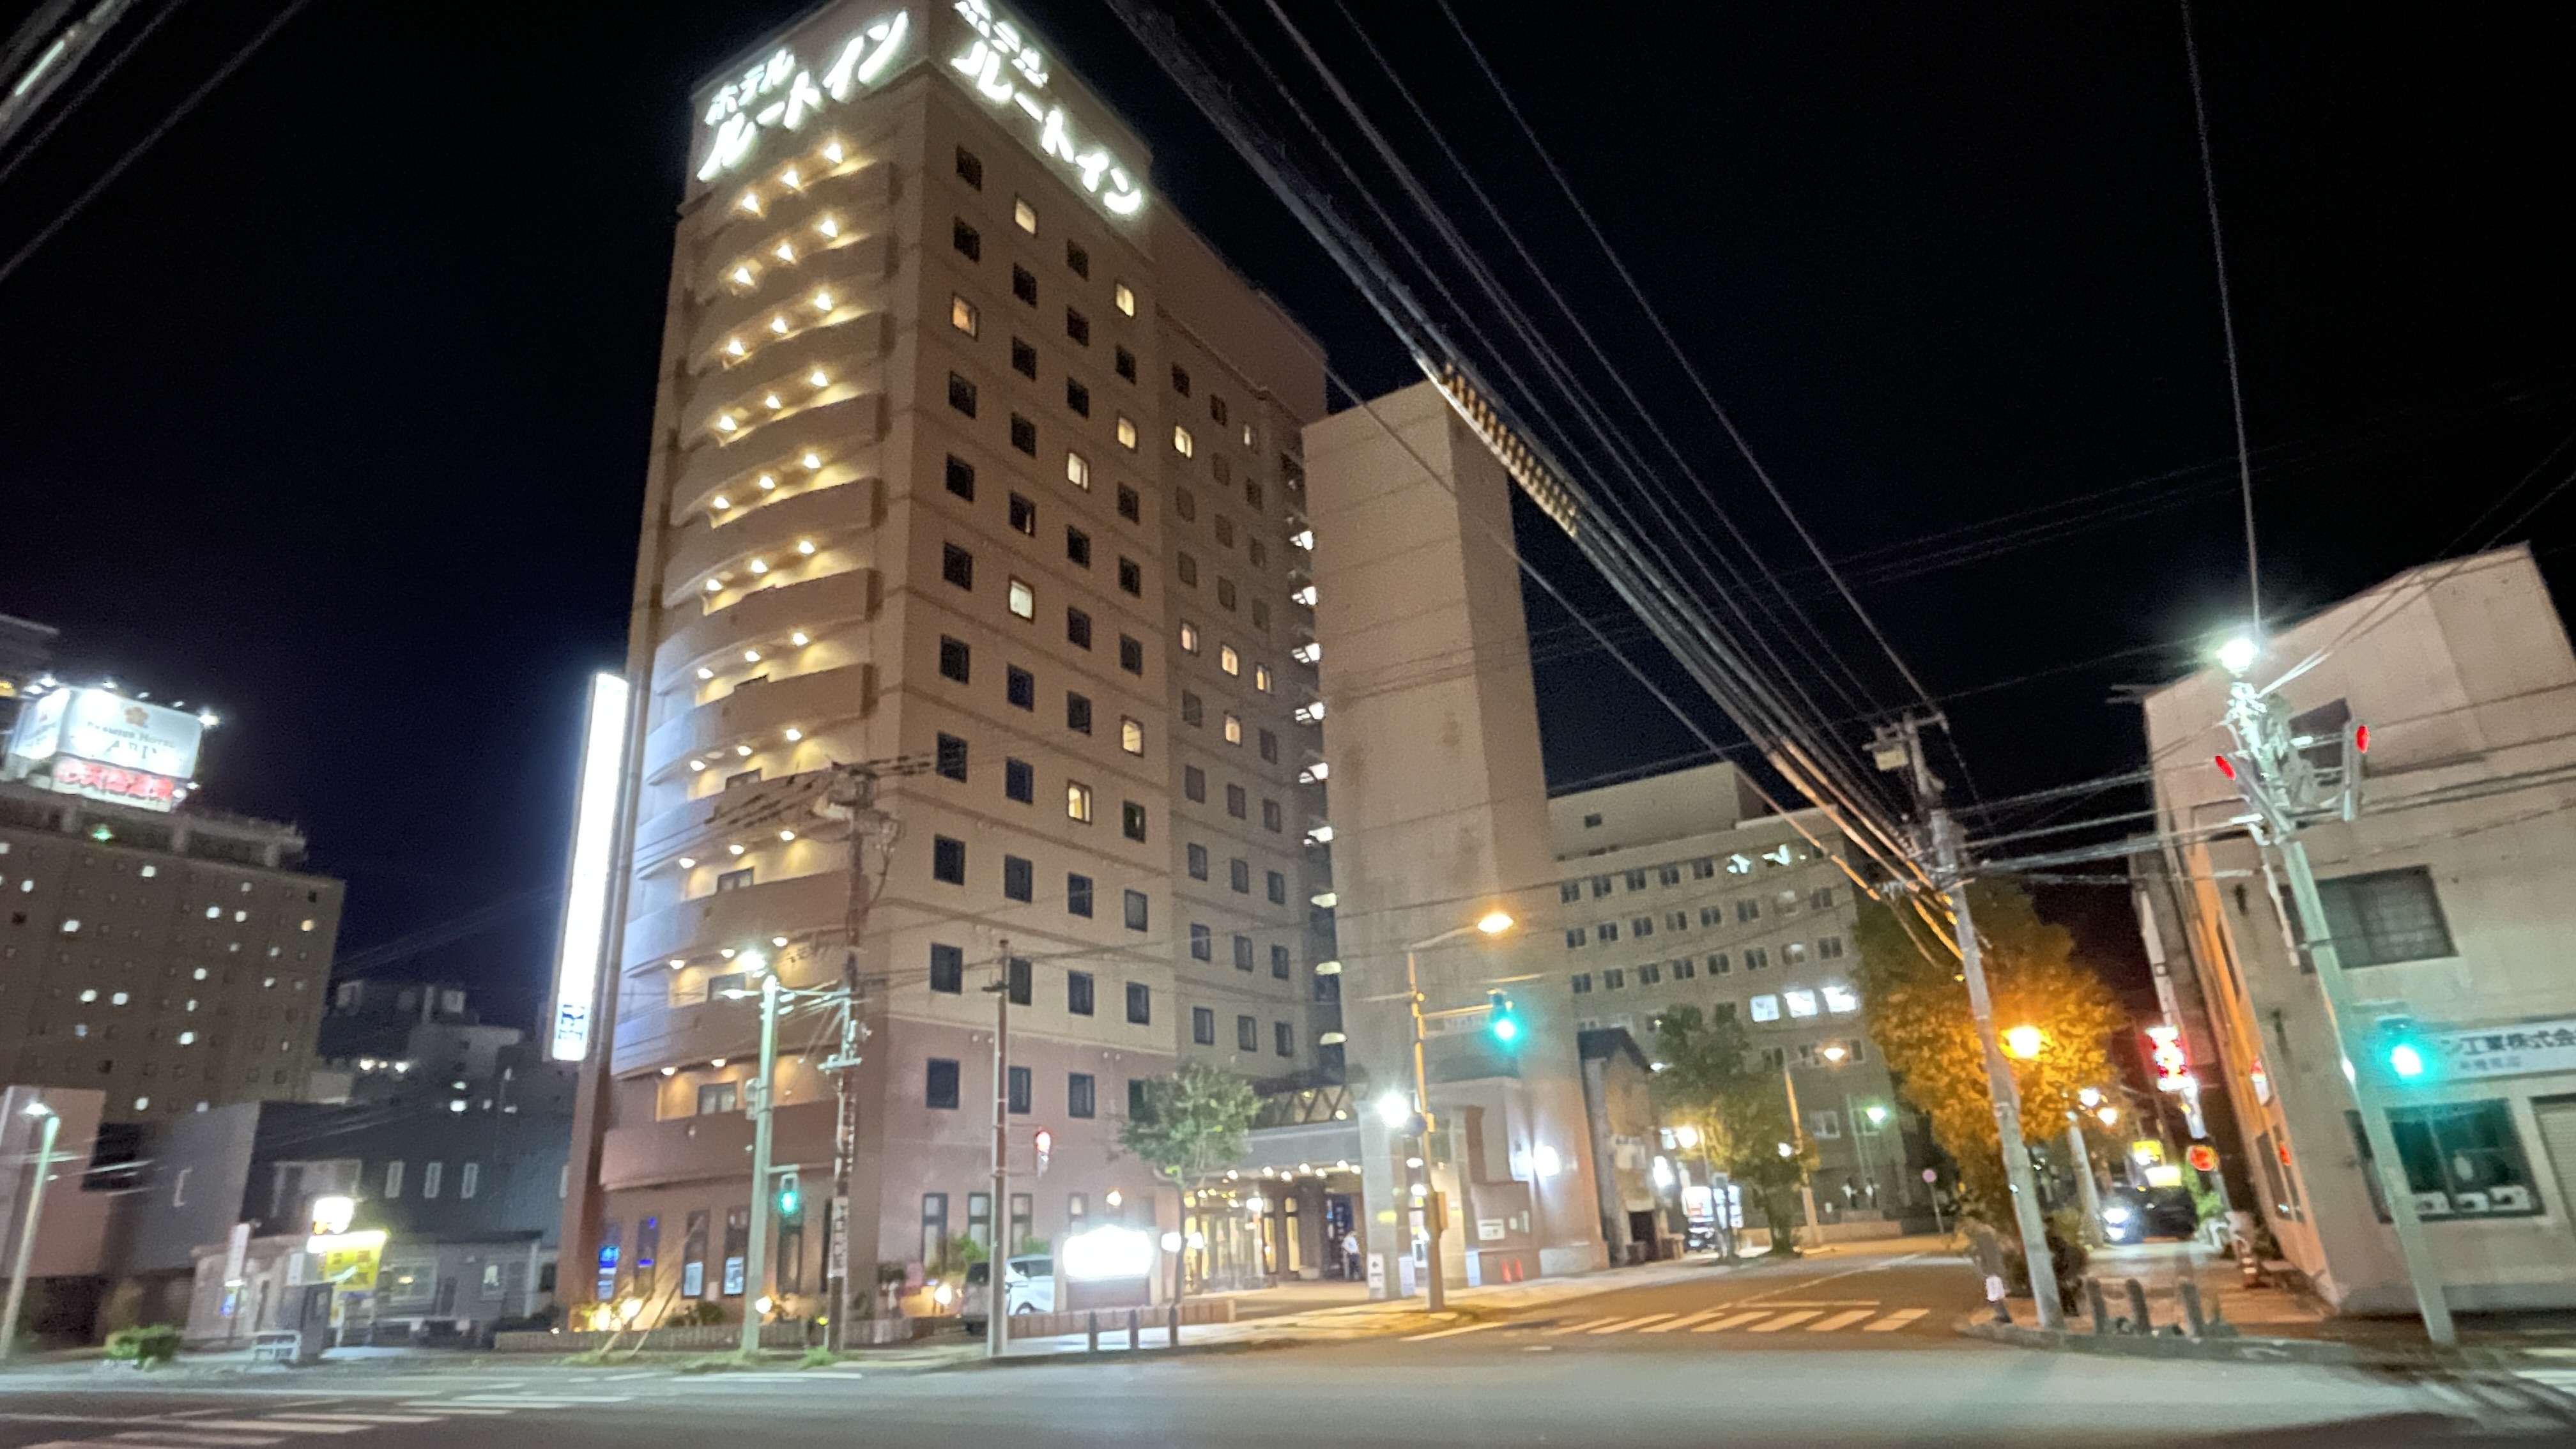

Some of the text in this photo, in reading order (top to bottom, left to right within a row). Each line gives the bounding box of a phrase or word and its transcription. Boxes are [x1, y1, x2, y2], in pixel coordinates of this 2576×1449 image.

[697, 11, 908, 181] ルートイン
[705, 49, 794, 125] ホテル
[954, 0, 1048, 89] ホテル
[951, 40, 1142, 213] ルートイン
